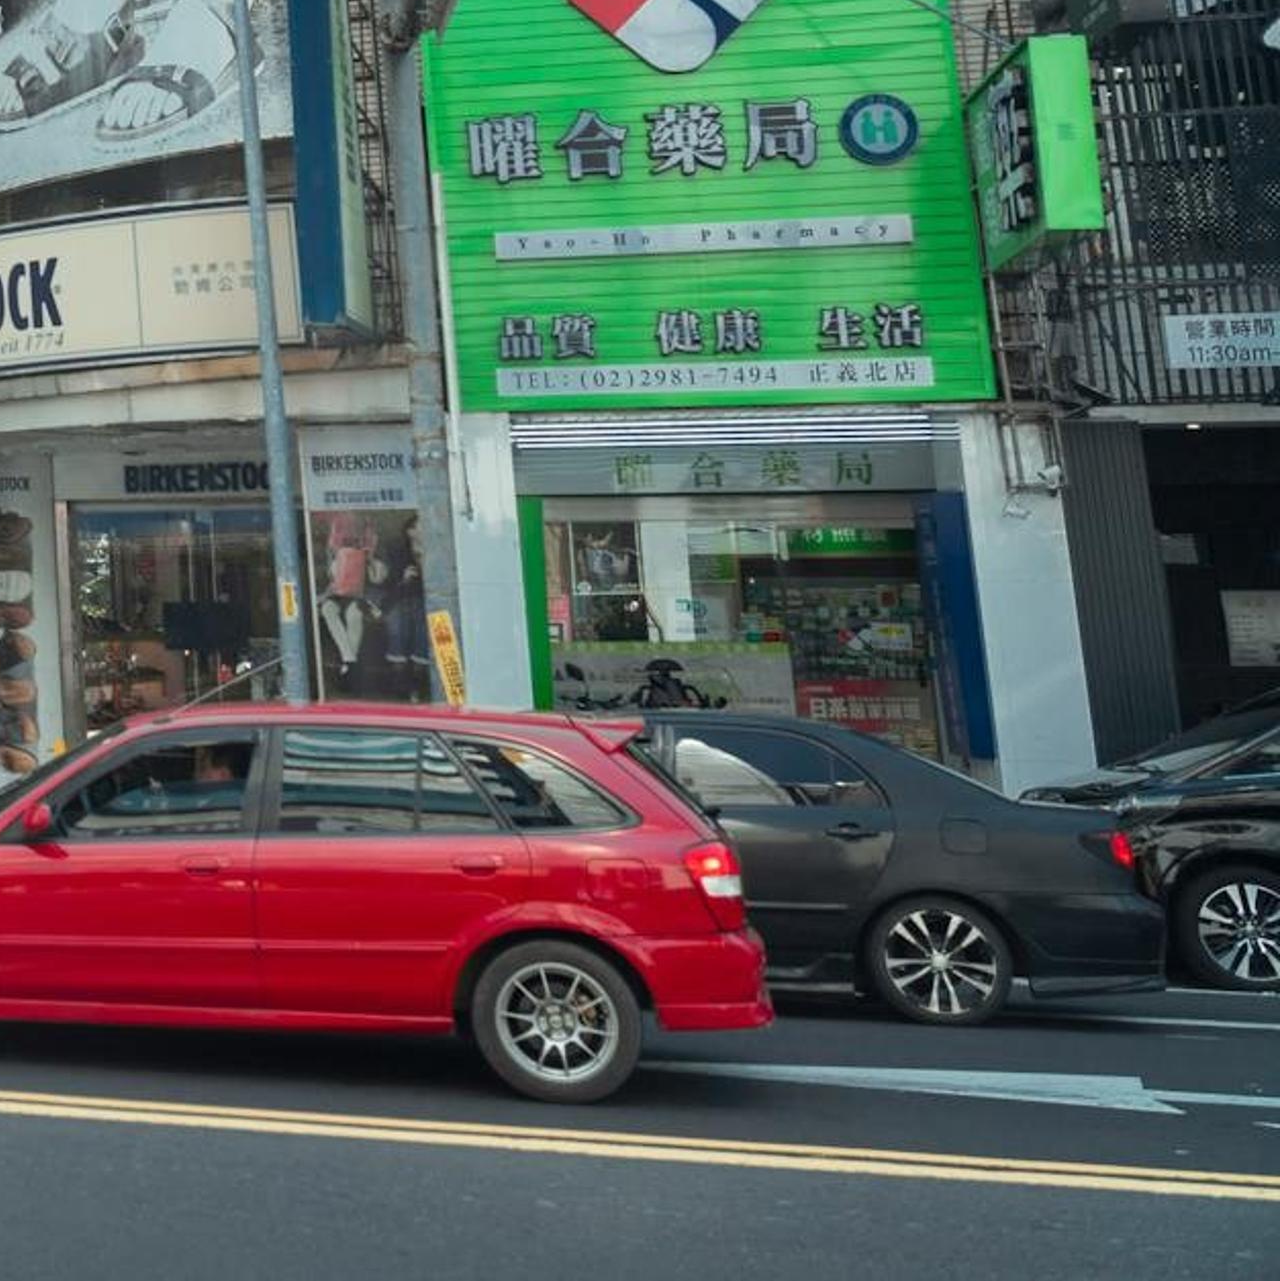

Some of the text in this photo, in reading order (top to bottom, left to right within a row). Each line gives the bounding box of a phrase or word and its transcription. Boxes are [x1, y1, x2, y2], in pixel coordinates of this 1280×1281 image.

[466, 97, 819, 184] 曜合藥局
[700, 222, 890, 243] Pharmacy
[499, 302, 923, 360] 品質 健康 生活
[1185, 317, 1275, 340] 營業時間
[809, 357, 917, 384] 正義北店
[311, 453, 405, 475] BIRKENSTOCK
[123, 461, 271, 495] BIRKENSTOC
